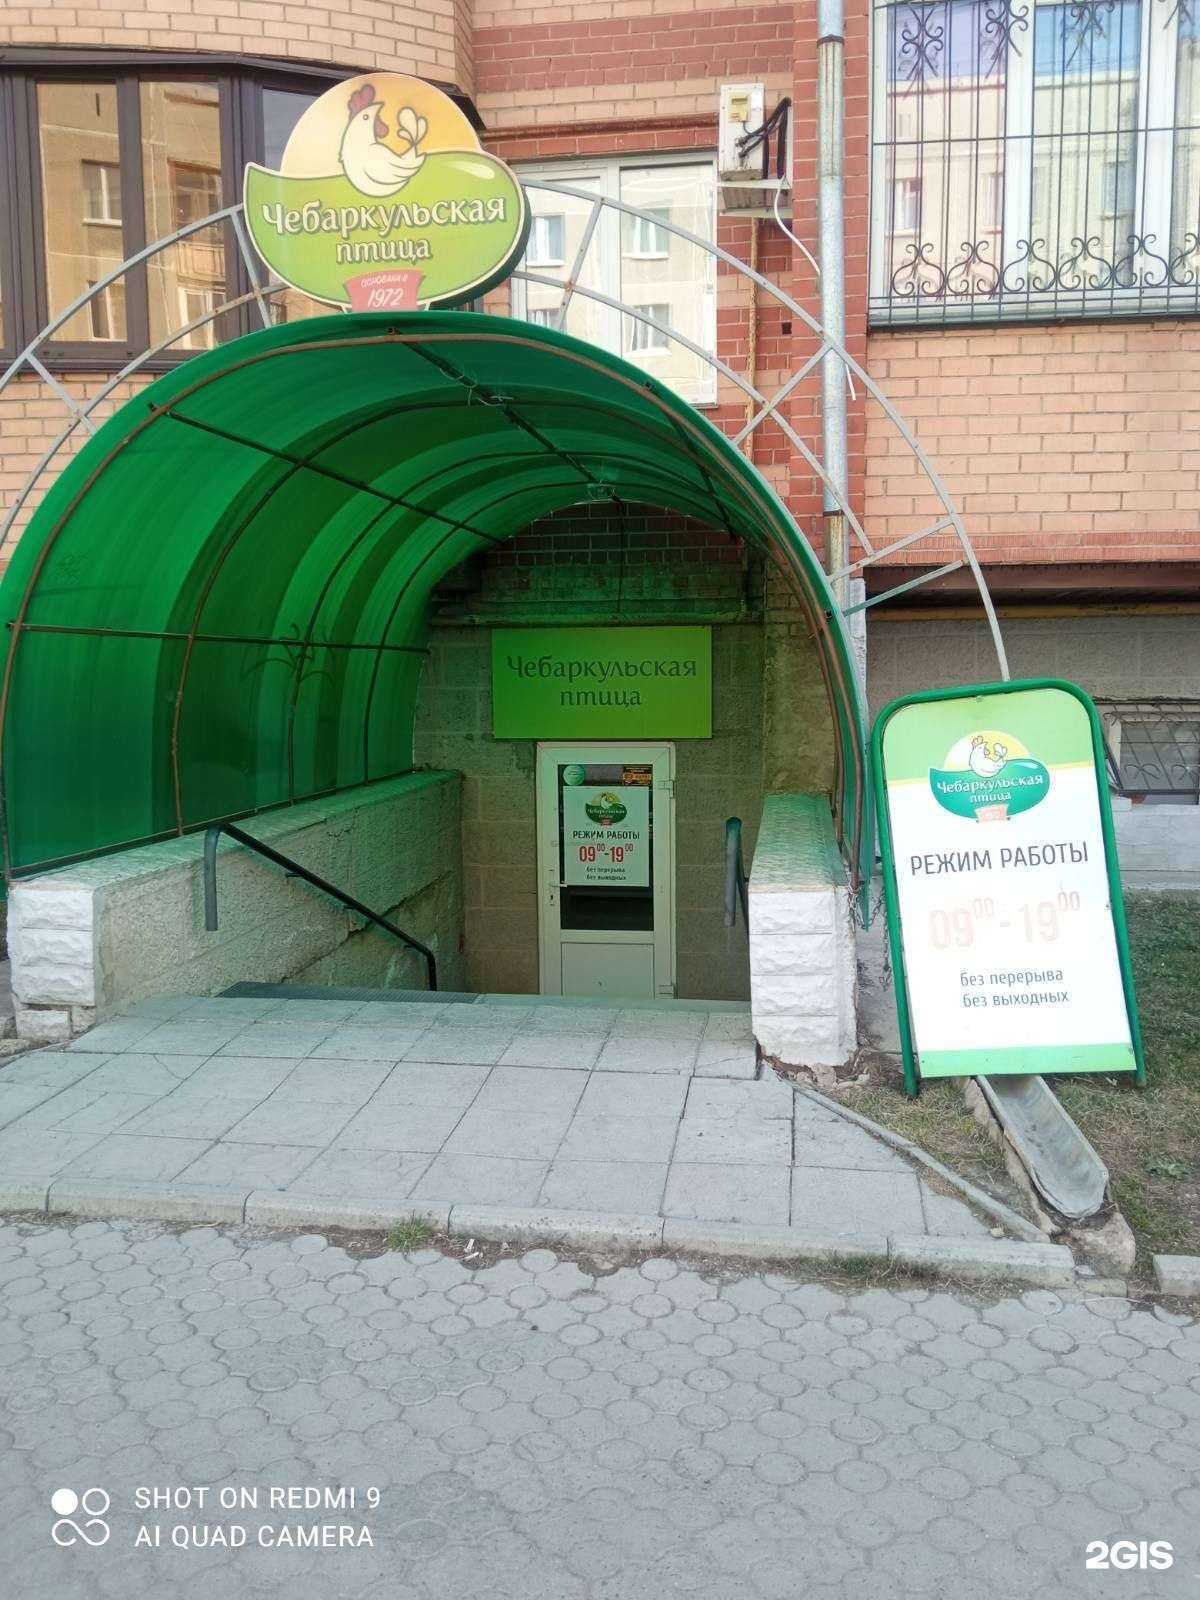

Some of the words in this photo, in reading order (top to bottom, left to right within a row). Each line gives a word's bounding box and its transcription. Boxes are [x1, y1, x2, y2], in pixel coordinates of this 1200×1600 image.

[262, 197, 505, 237] Чебаркульская
[336, 239, 431, 264] птица
[368, 288, 404, 308] 1972
[507, 655, 697, 682] Чебаркульская
[560, 690, 642, 708] птица
[936, 775, 1043, 793] Чебаркульская
[573, 830, 604, 839] РЕЖИМ
[606, 830, 640, 839] РАБОТЫ
[910, 850, 992, 876] РЕЖИМ
[1000, 841, 1088, 868] РАБОТЫ
[960, 972, 985, 986] без
[990, 969, 1063, 987] перерыва
[963, 994, 987, 1008] без
[993, 991, 1070, 1006] выходных
